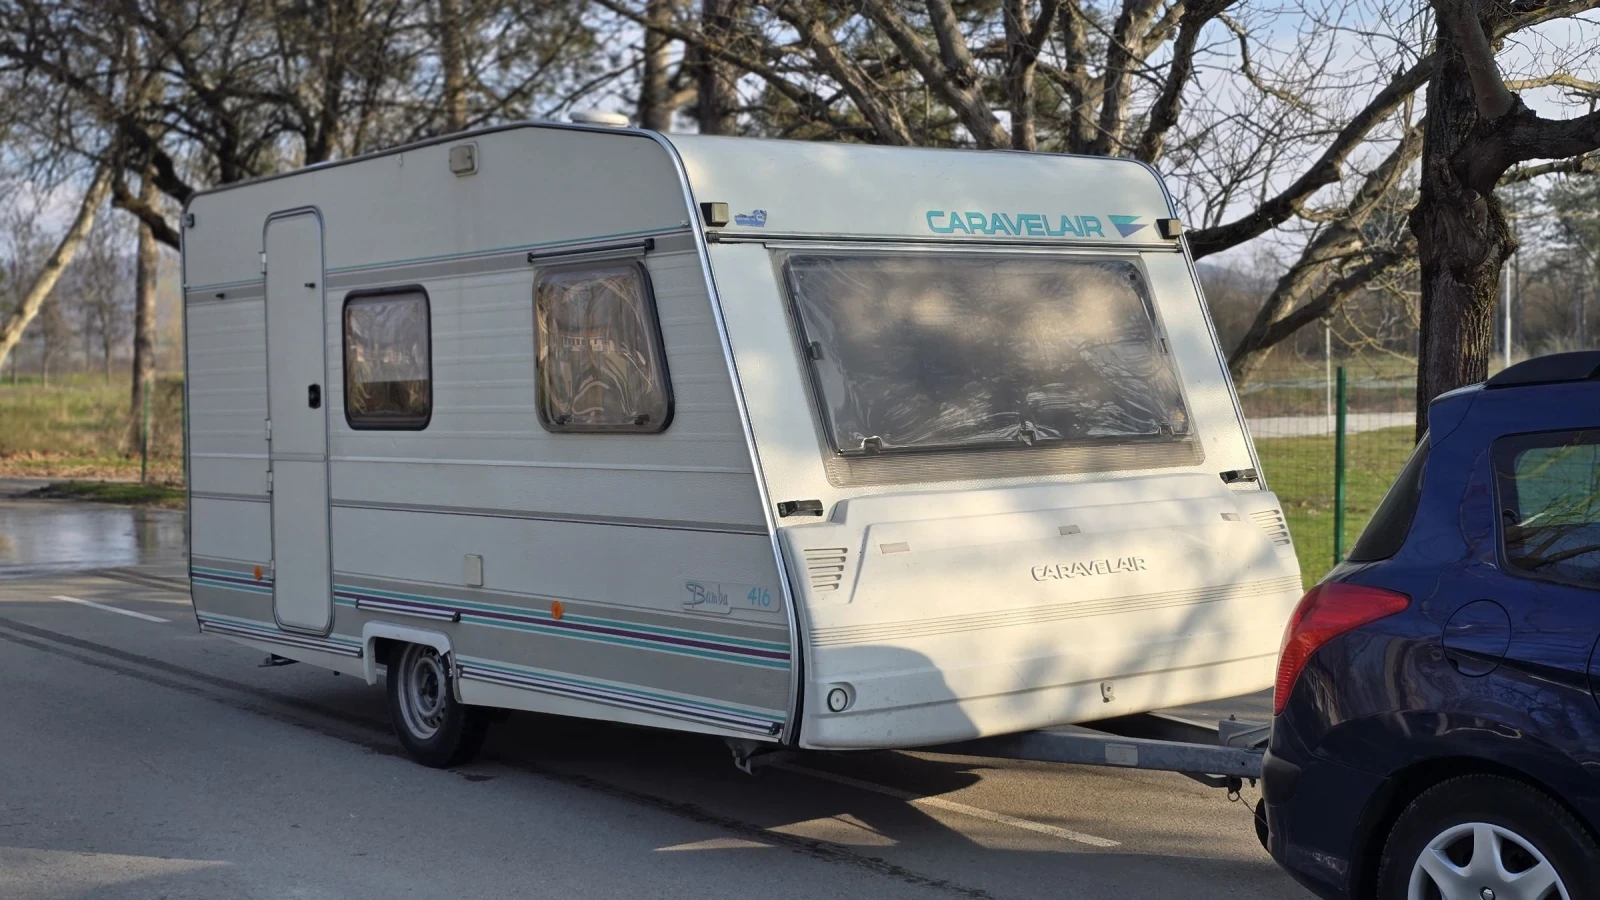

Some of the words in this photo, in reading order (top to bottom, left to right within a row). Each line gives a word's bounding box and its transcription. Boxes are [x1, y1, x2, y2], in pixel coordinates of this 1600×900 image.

[926, 210, 1105, 237] CARAVELAIR
[1031, 556, 1147, 582] CARAVELAIR
[683, 581, 729, 608] Bamba
[747, 586, 771, 608] 416
